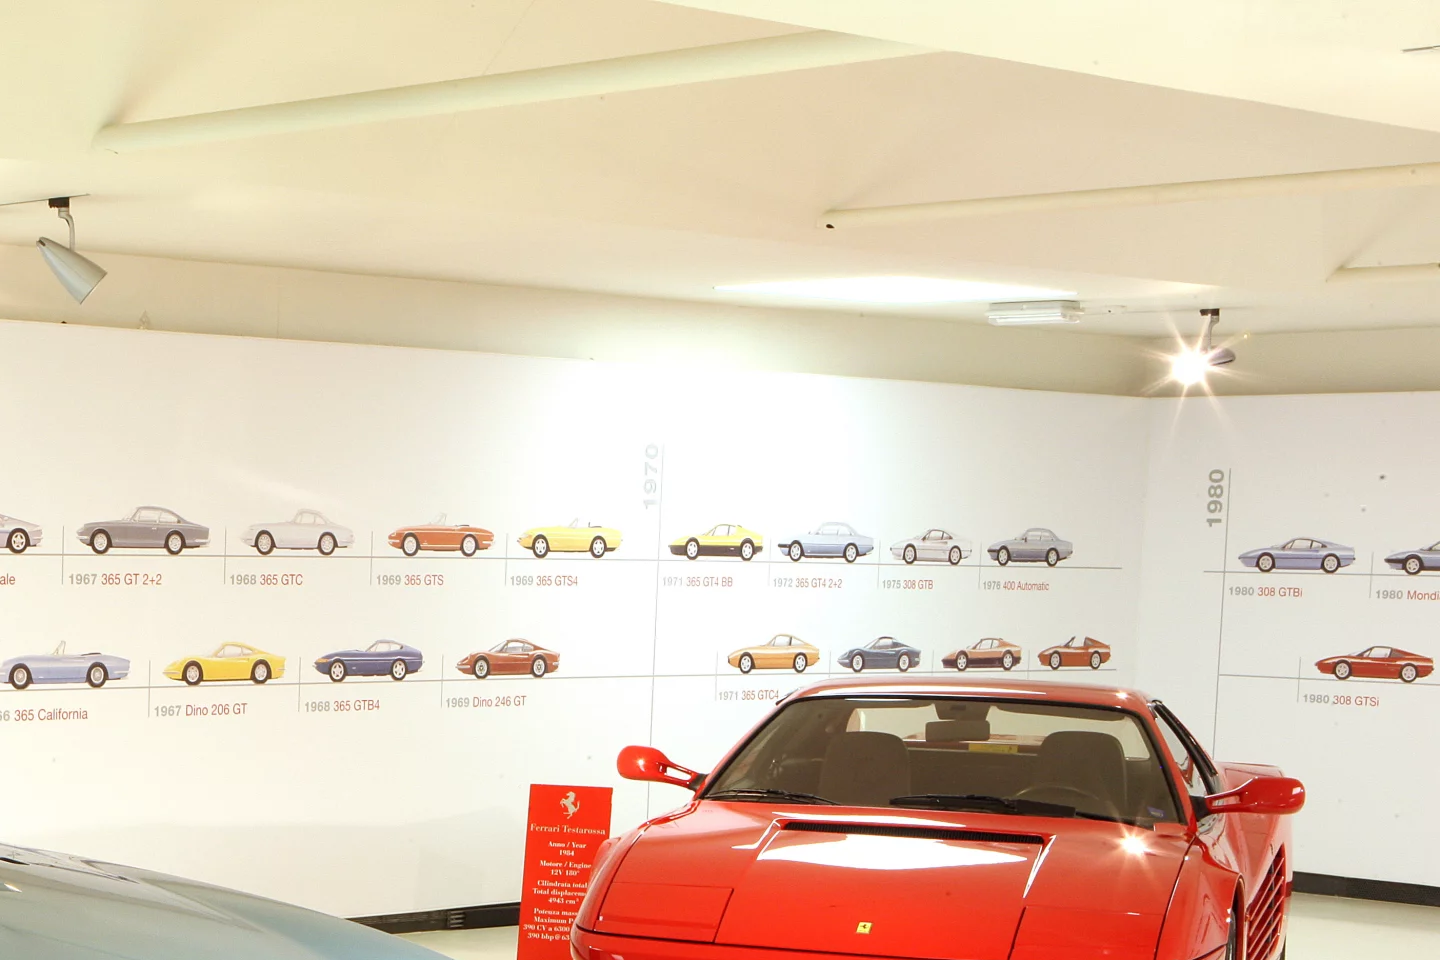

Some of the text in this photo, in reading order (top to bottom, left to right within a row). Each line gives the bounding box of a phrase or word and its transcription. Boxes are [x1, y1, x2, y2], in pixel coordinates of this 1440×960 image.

[643, 444, 658, 510] 1970
[1206, 469, 1224, 527] 1980
[69, 573, 162, 585] 1967 365 GT 2+2
[230, 574, 303, 585] 1968 365 GTC
[377, 574, 444, 585] 1969 365 GTS
[510, 575, 578, 586] 1969 365 GTS4
[662, 577, 733, 588] 1971 365 GT4 BB
[774, 578, 842, 588] 1972 365 GT4 2+2
[903, 580, 916, 589] 308
[918, 580, 933, 589] GTB
[1003, 581, 1016, 590] 400
[1016, 582, 1049, 591] Automatic
[1229, 586, 1302, 597] 1980 308 GTBi
[1376, 590, 1403, 599] 1980
[719, 689, 779, 701] 1971 365 GTC4
[1303, 694, 1379, 706] 1980 308 GTSi
[305, 700, 380, 712] 1968 365 GTB4
[446, 695, 527, 708] 1969 Dino 246 GT
[14, 709, 34, 721] 365
[38, 708, 88, 721] California
[155, 703, 247, 716] 1967 Dino 206 GT
[530, 823, 606, 835] Ferrari Testarossa
[559, 849, 575, 857] 1984
[569, 862, 592, 870] Engine
[537, 879, 571, 888] Cilindrata
[550, 888, 588, 898] displacem
[533, 907, 560, 916] Potenza
[534, 916, 567, 924] Maximum
